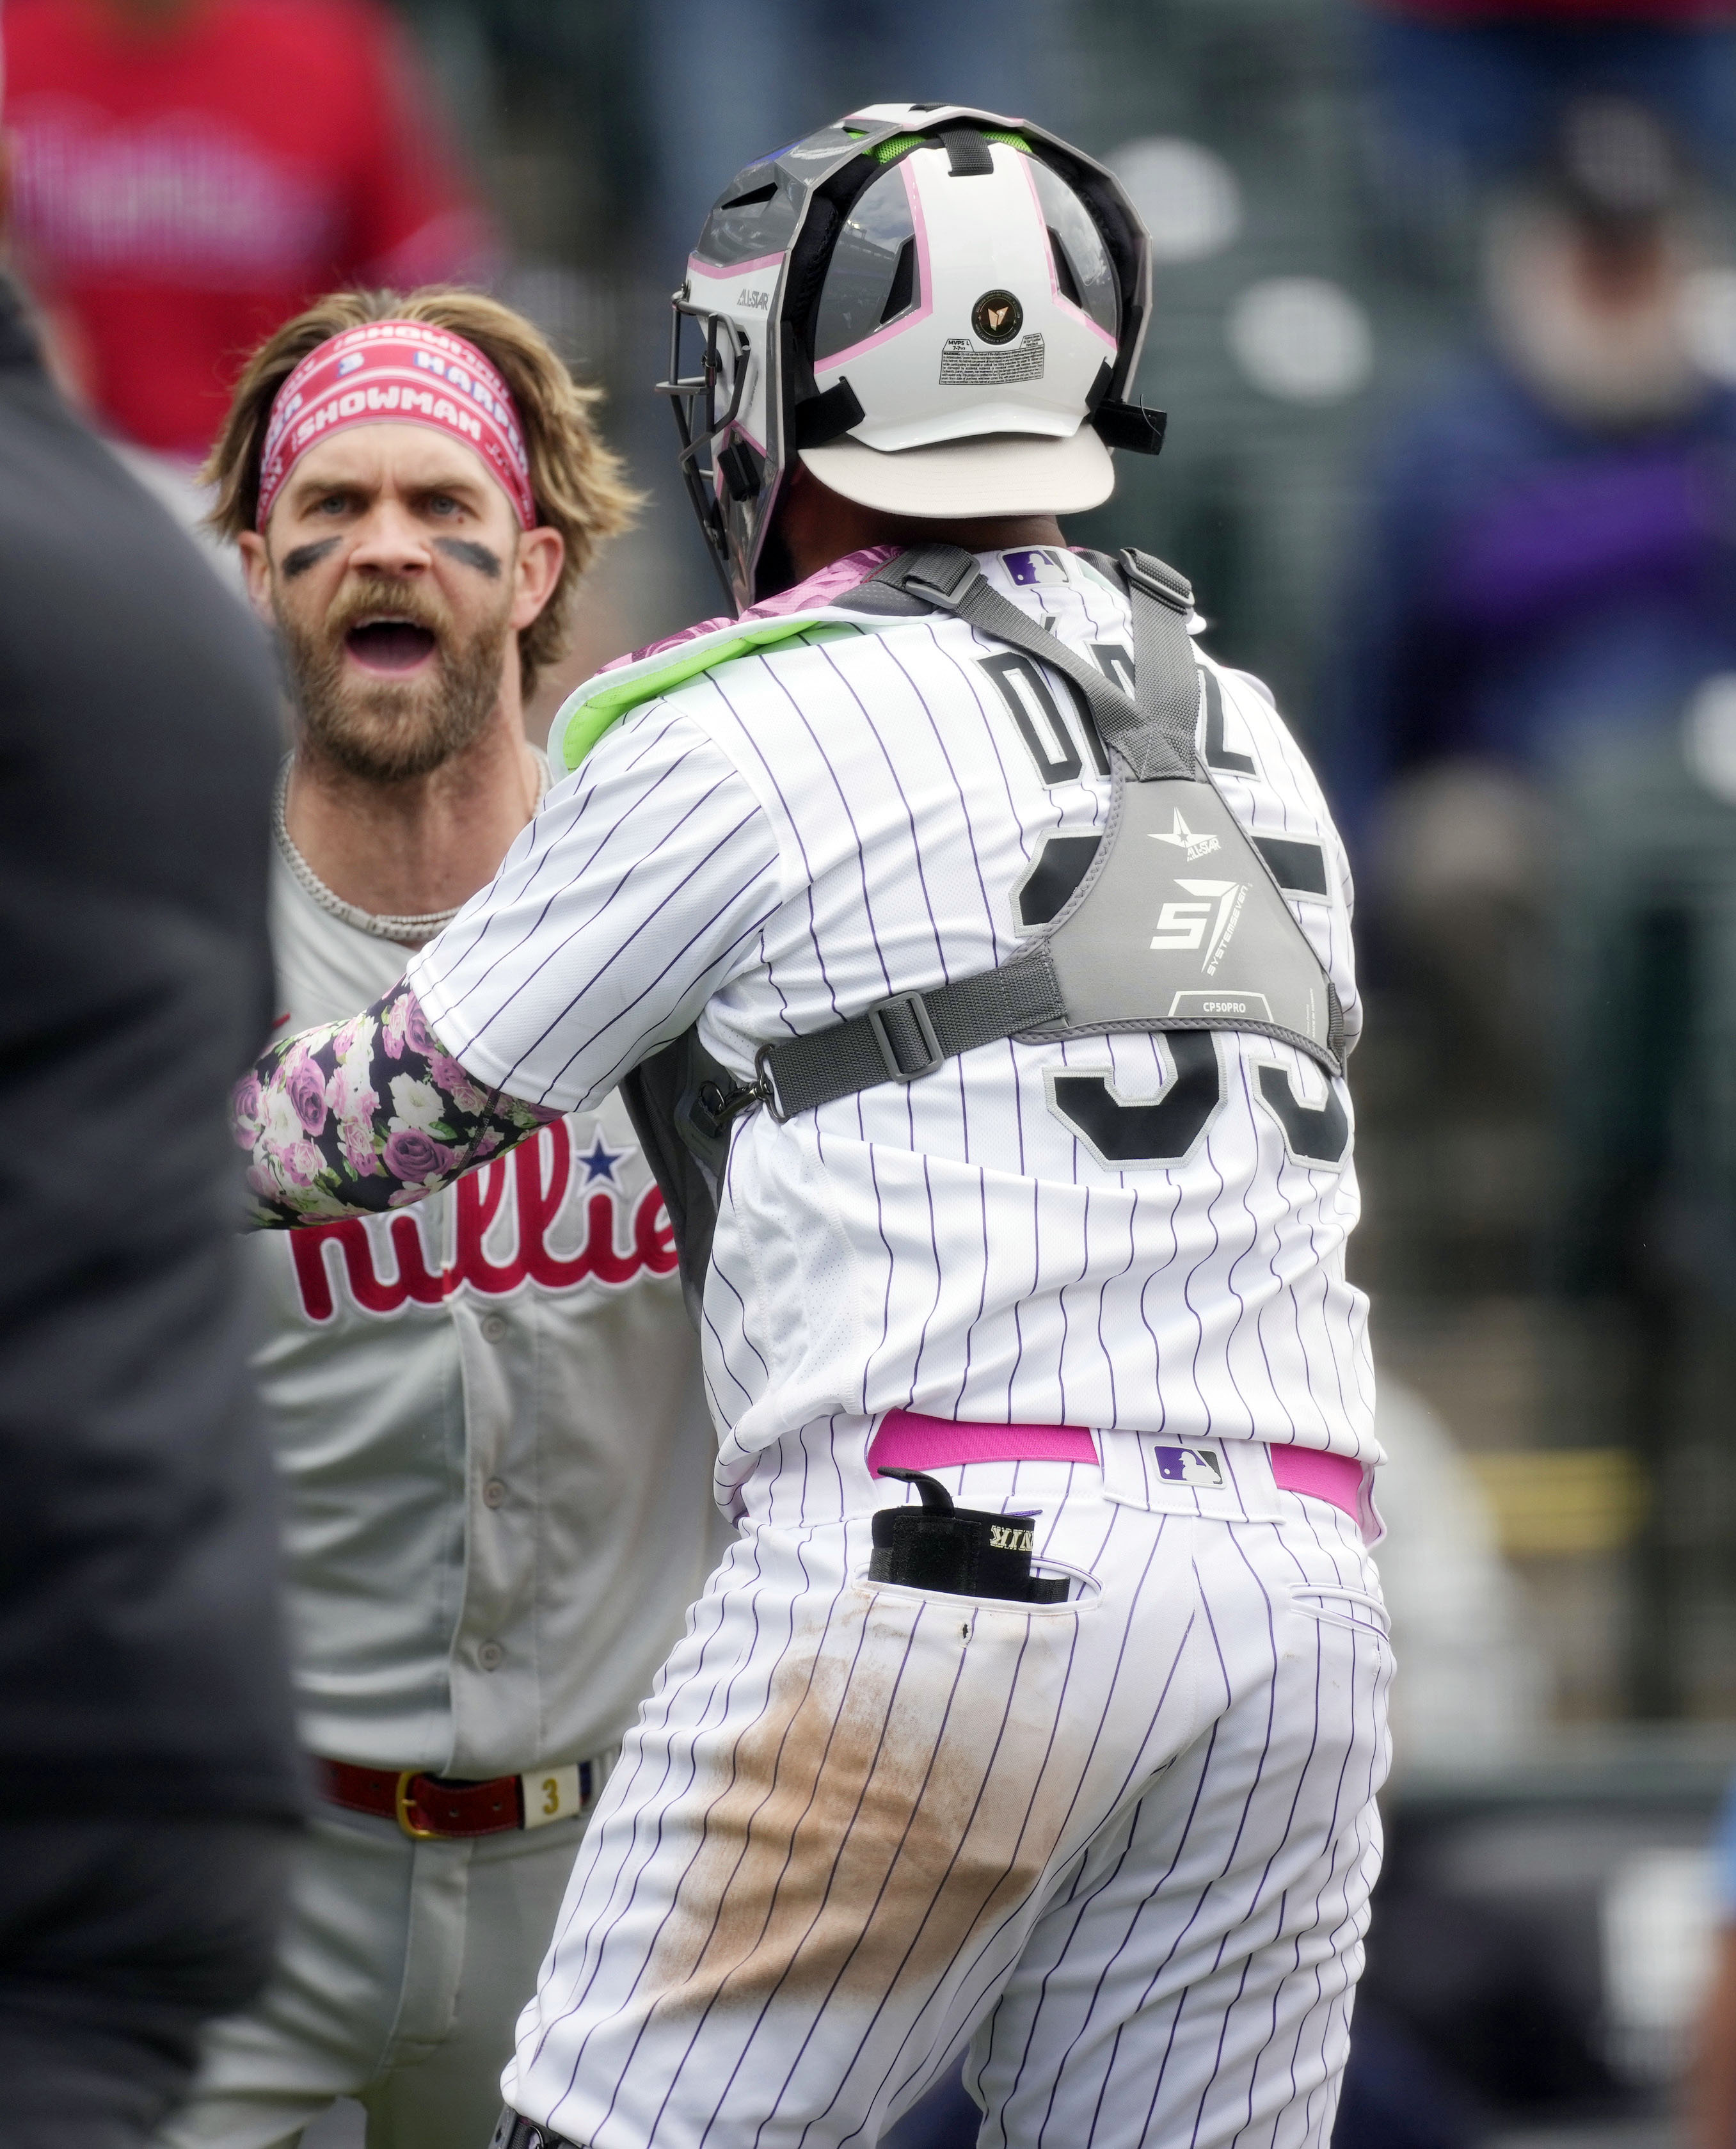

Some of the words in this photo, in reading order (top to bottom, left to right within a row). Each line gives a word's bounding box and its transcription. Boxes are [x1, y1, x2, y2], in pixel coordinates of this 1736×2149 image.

[296, 385, 482, 442] SHOWMAN
[1186, 838, 1221, 863] ALL-STAR
[1202, 1002, 1246, 1014] CP50PRO
[543, 1778, 559, 1814] 3
